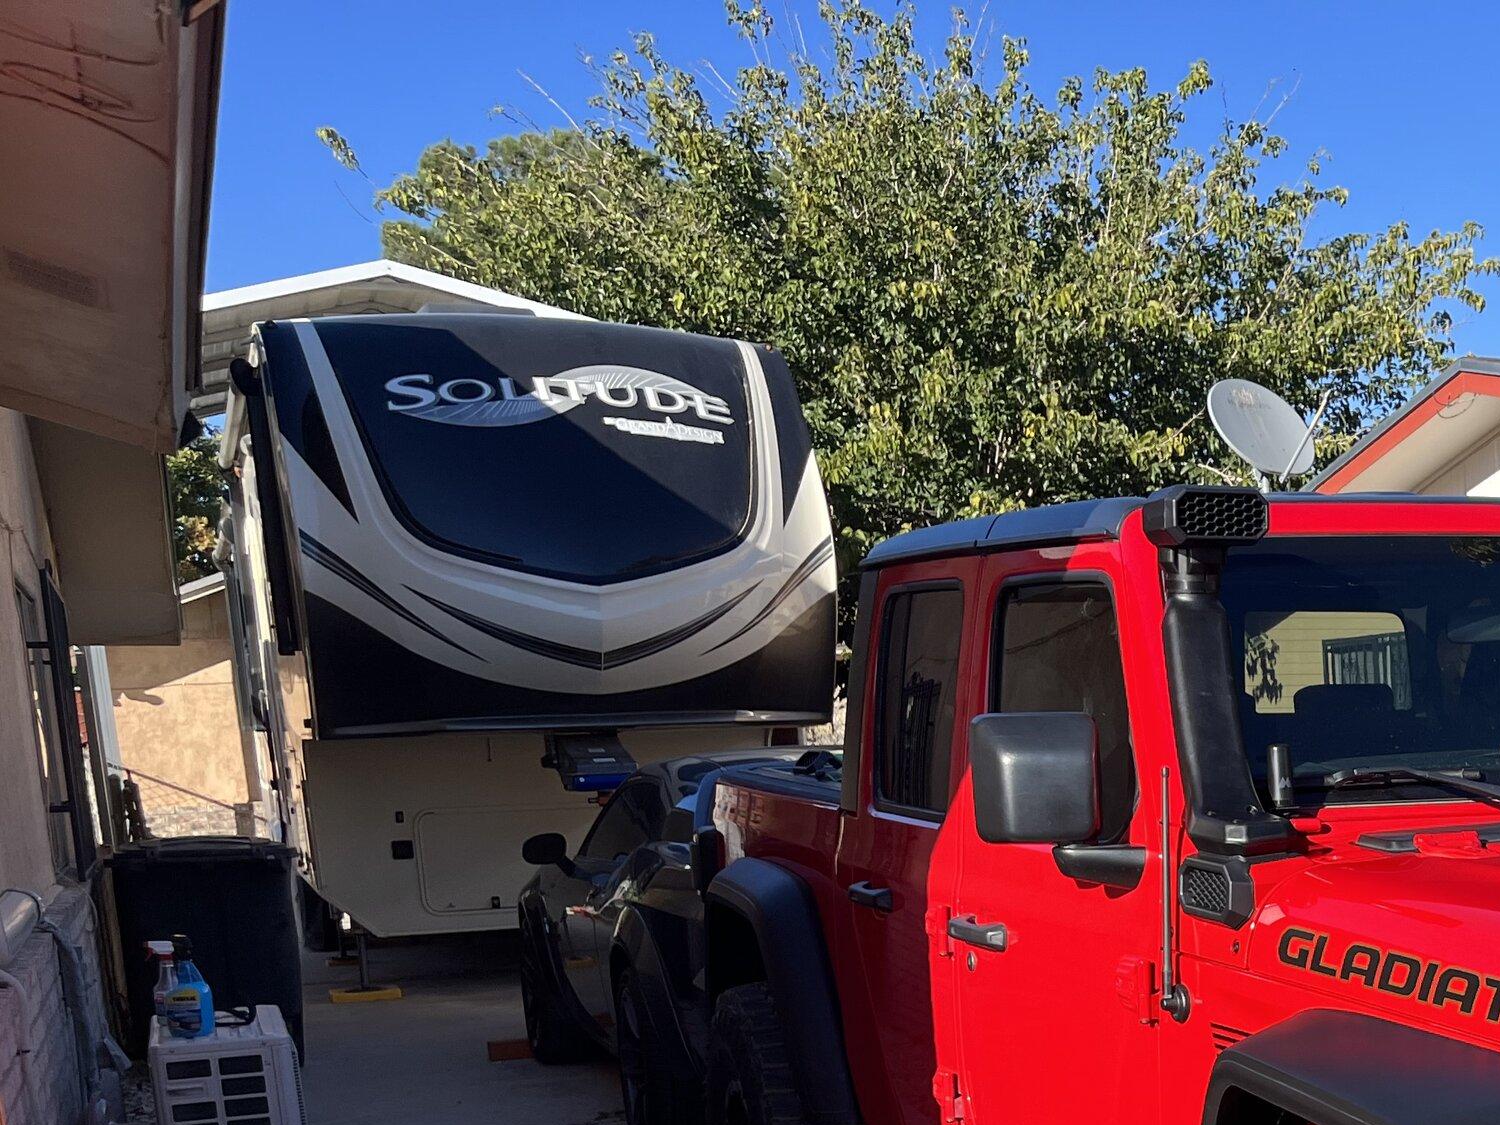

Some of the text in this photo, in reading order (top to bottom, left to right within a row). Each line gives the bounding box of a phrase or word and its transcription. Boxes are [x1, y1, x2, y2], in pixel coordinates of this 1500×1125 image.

[384, 372, 735, 427] SOLITUDE
[616, 418, 724, 442] GRAND DESIGN
